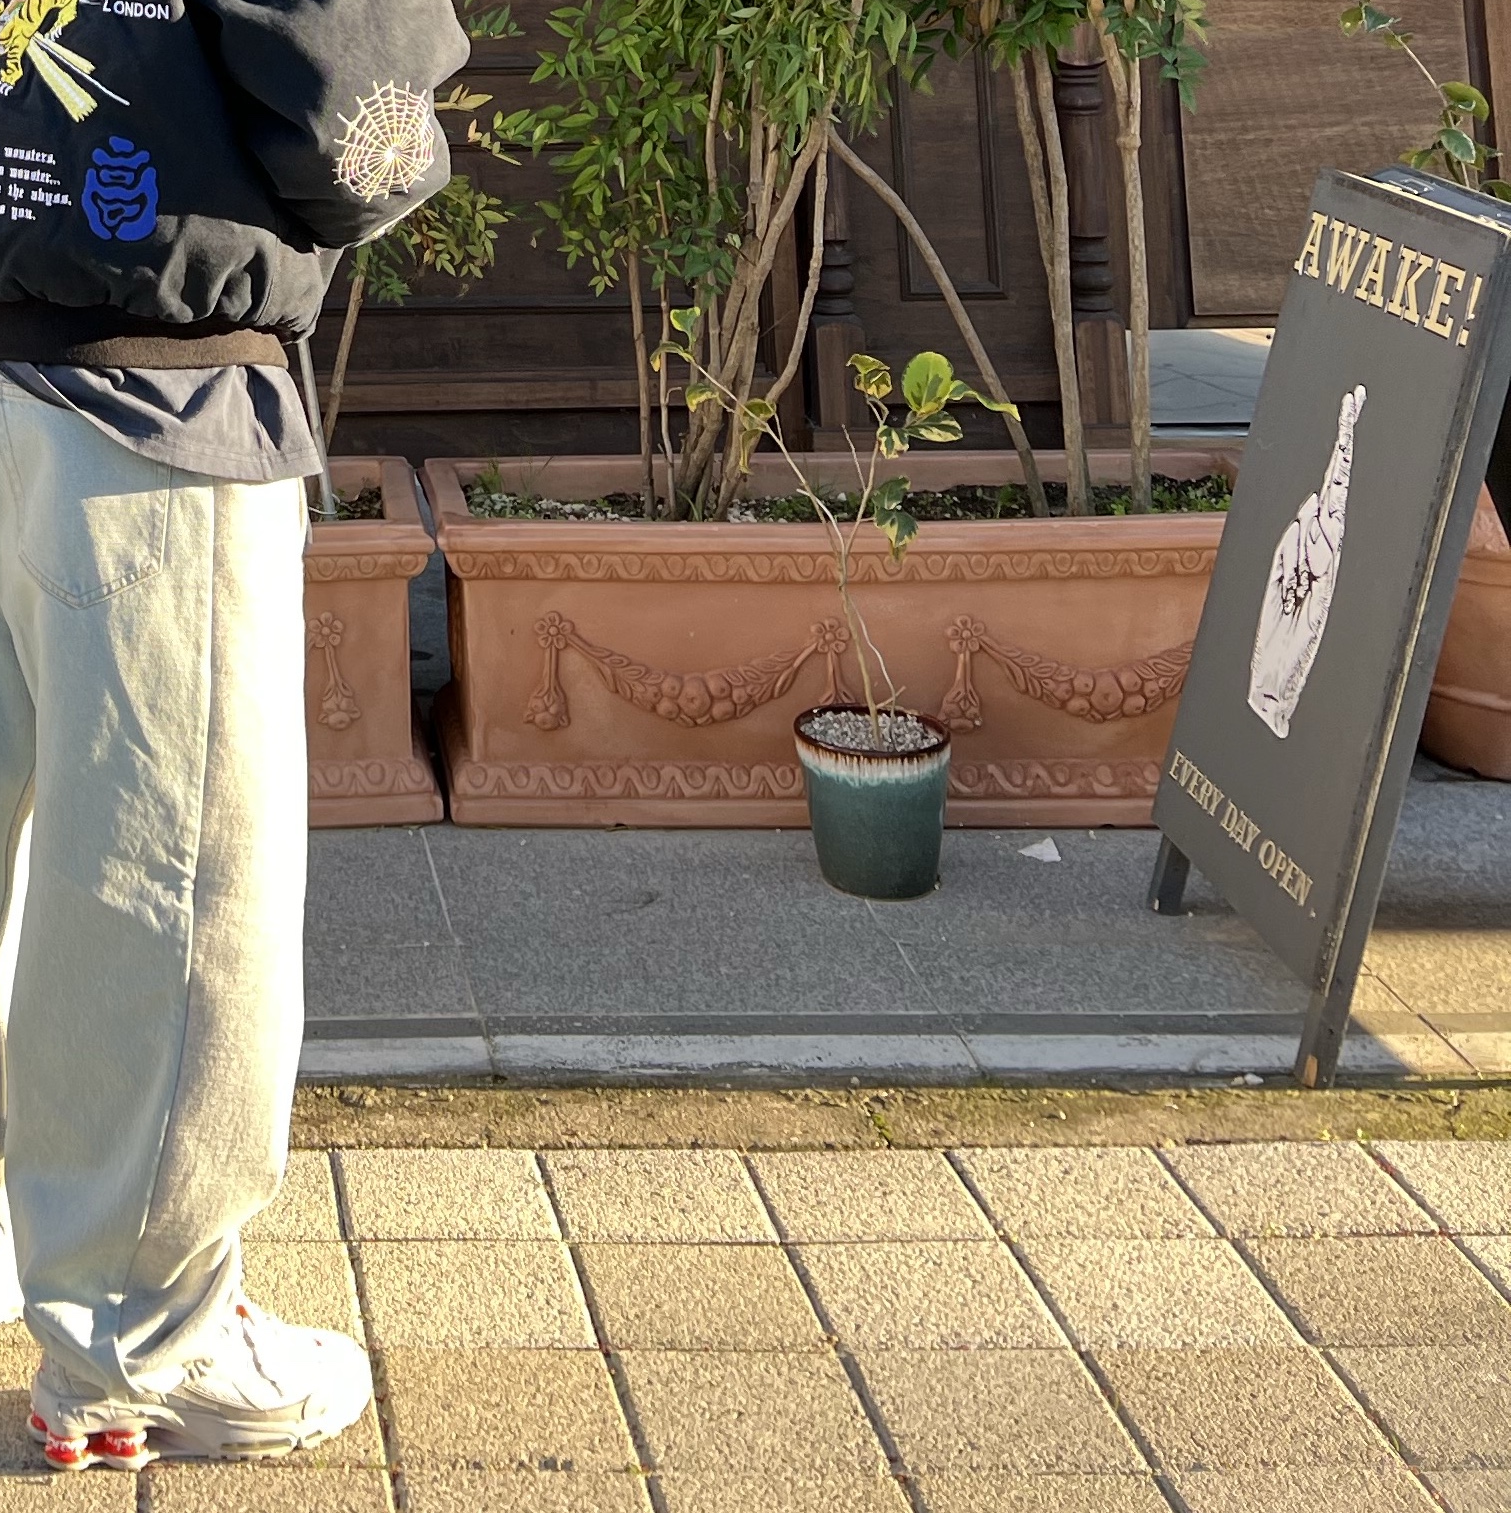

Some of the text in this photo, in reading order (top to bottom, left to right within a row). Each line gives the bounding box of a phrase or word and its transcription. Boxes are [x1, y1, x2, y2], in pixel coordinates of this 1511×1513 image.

[1293, 210, 1483, 348] AWAKE!
[1169, 748, 1225, 817] EVERY
[1219, 798, 1261, 853] DAY
